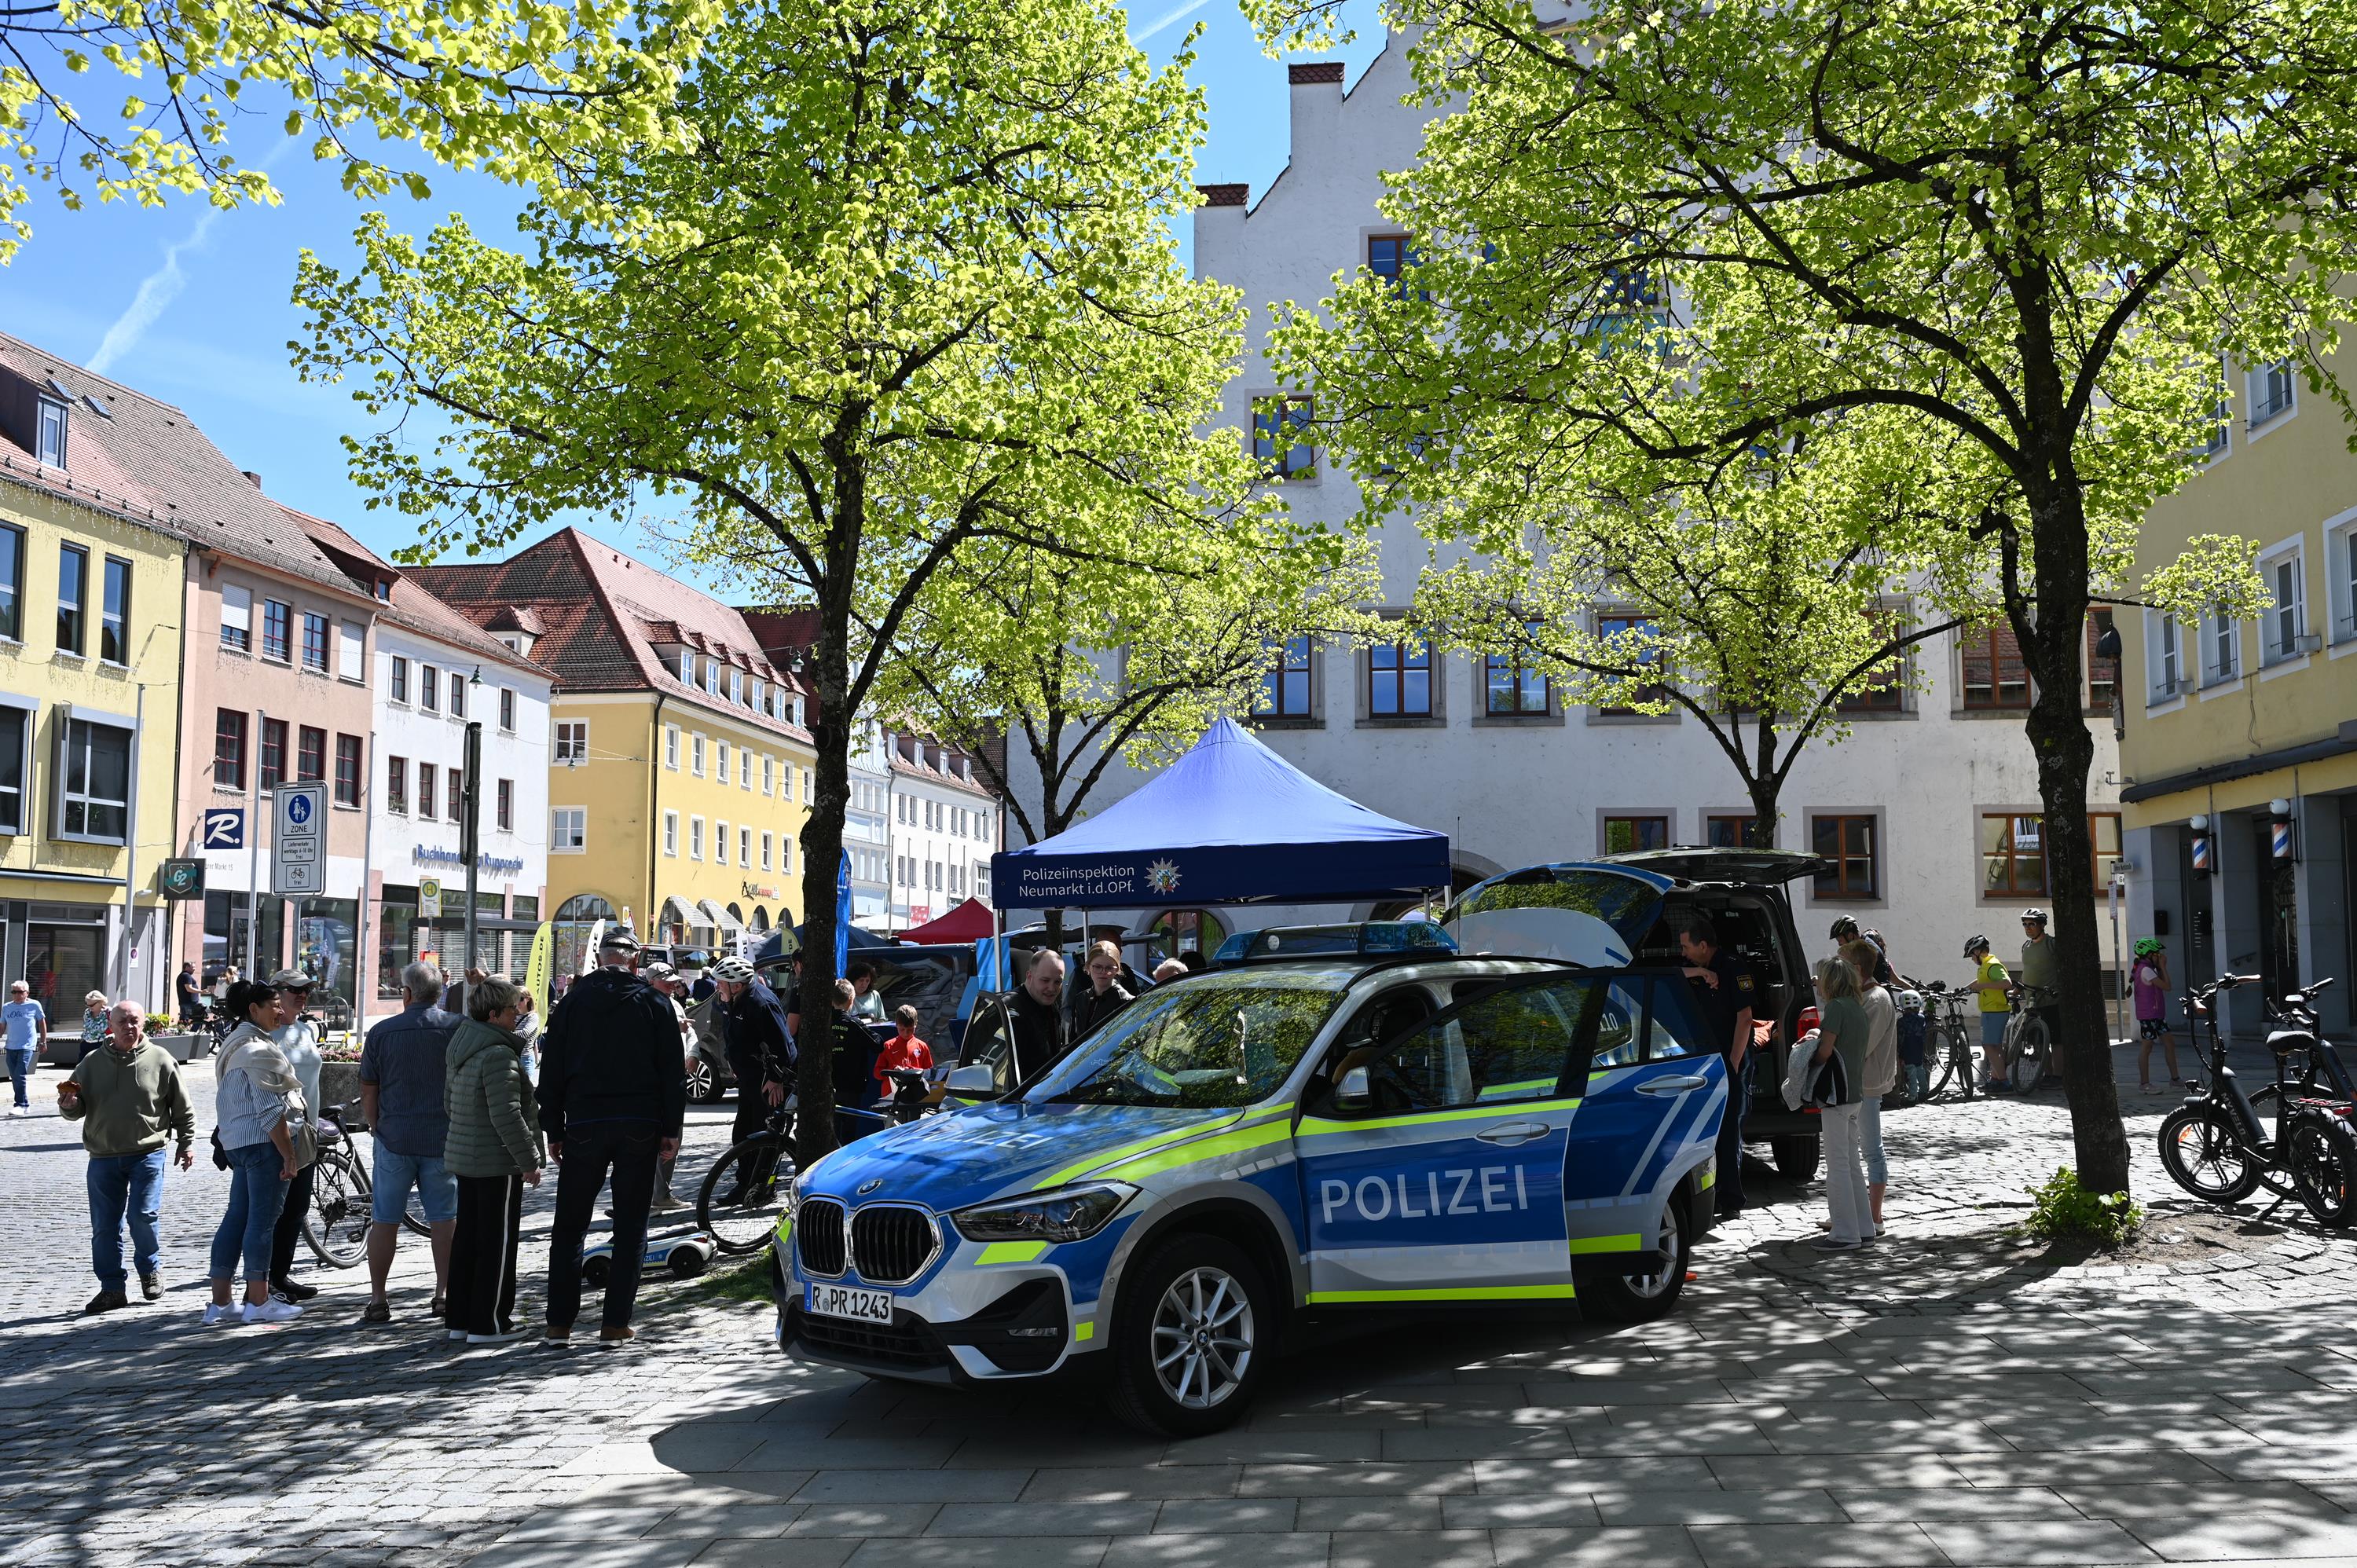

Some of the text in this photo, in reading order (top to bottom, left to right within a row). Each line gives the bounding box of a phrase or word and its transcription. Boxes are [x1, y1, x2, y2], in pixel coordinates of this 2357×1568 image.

[485, 852, 523, 871] Rupprecht
[174, 870, 187, 886] G2
[1023, 865, 1135, 881] Polizeiinspektion
[1018, 880, 1135, 897] Neumarkt i.d.OPf.
[1321, 1164, 1528, 1224] POLIZEI
[812, 1286, 889, 1320] R PR 1243
